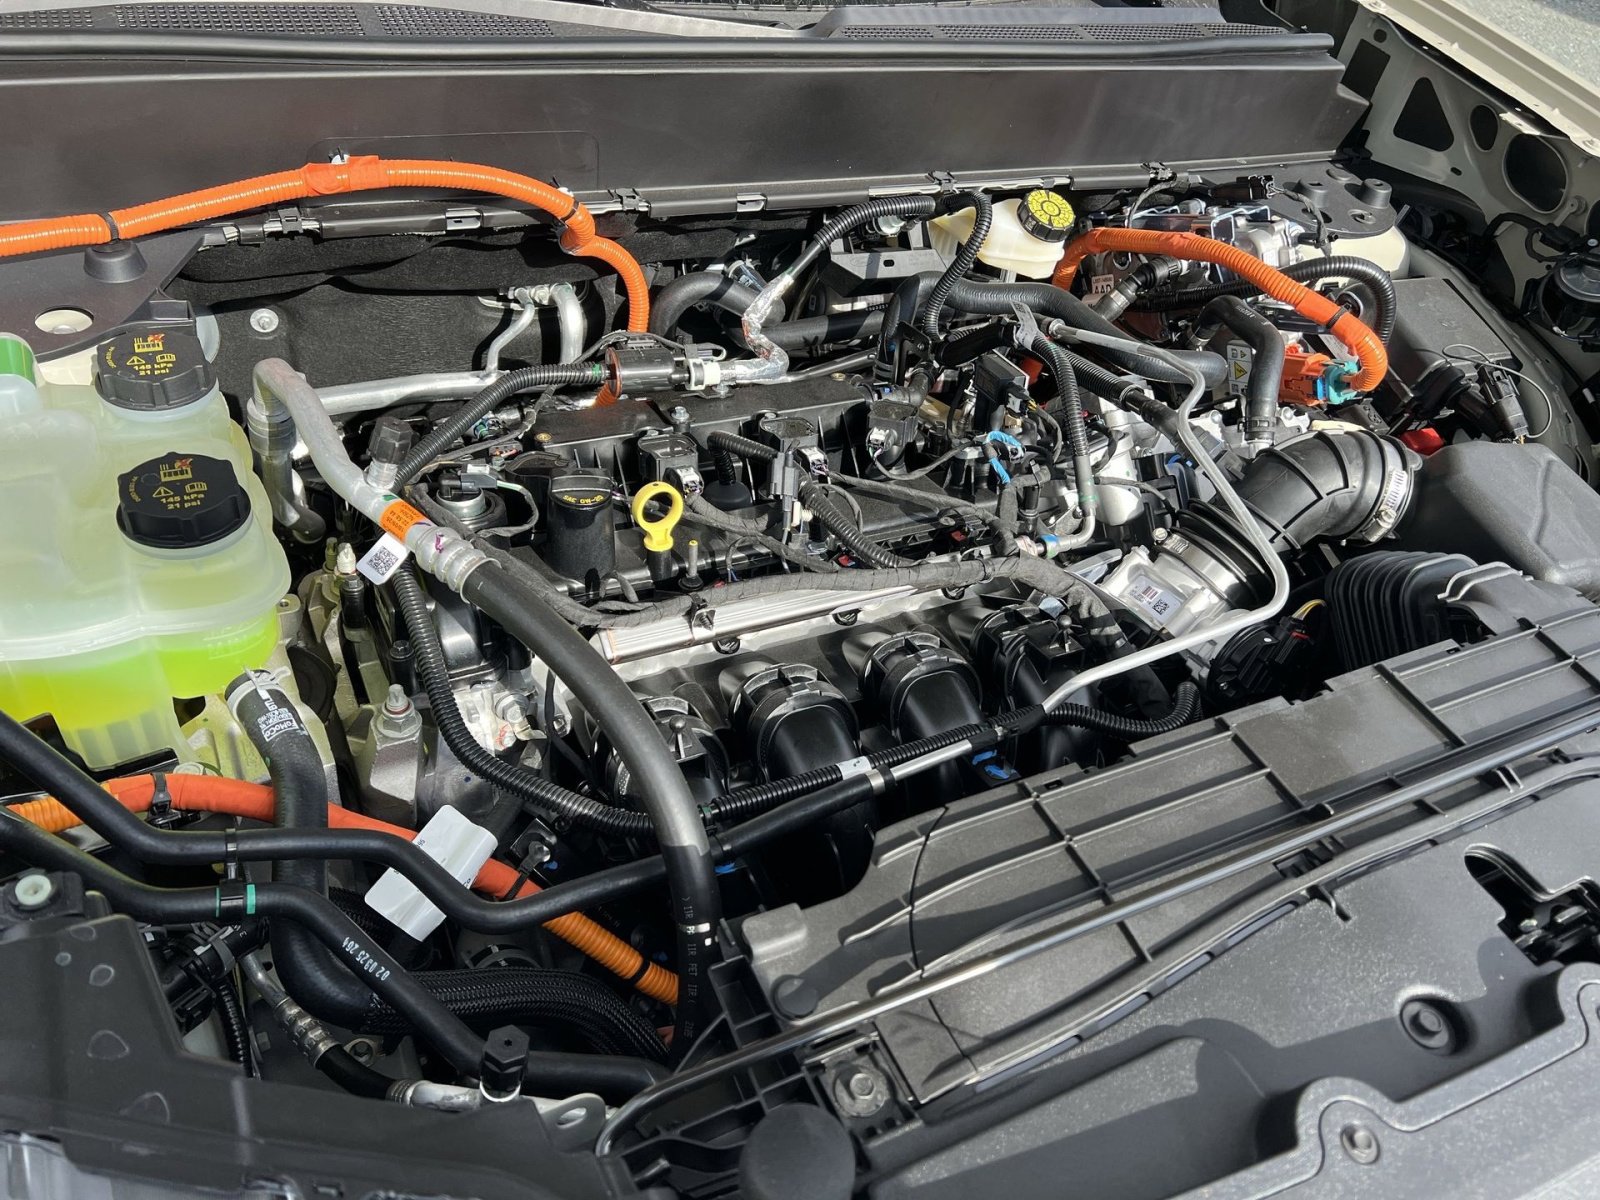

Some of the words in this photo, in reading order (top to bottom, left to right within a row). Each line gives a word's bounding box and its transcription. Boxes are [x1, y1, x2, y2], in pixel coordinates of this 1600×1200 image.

[160, 496, 181, 504] 145
[184, 493, 205, 501] kPa
[562, 495, 577, 504] SAE
[184, 501, 201, 509] psi
[264, 719, 298, 738] FoMoCo
